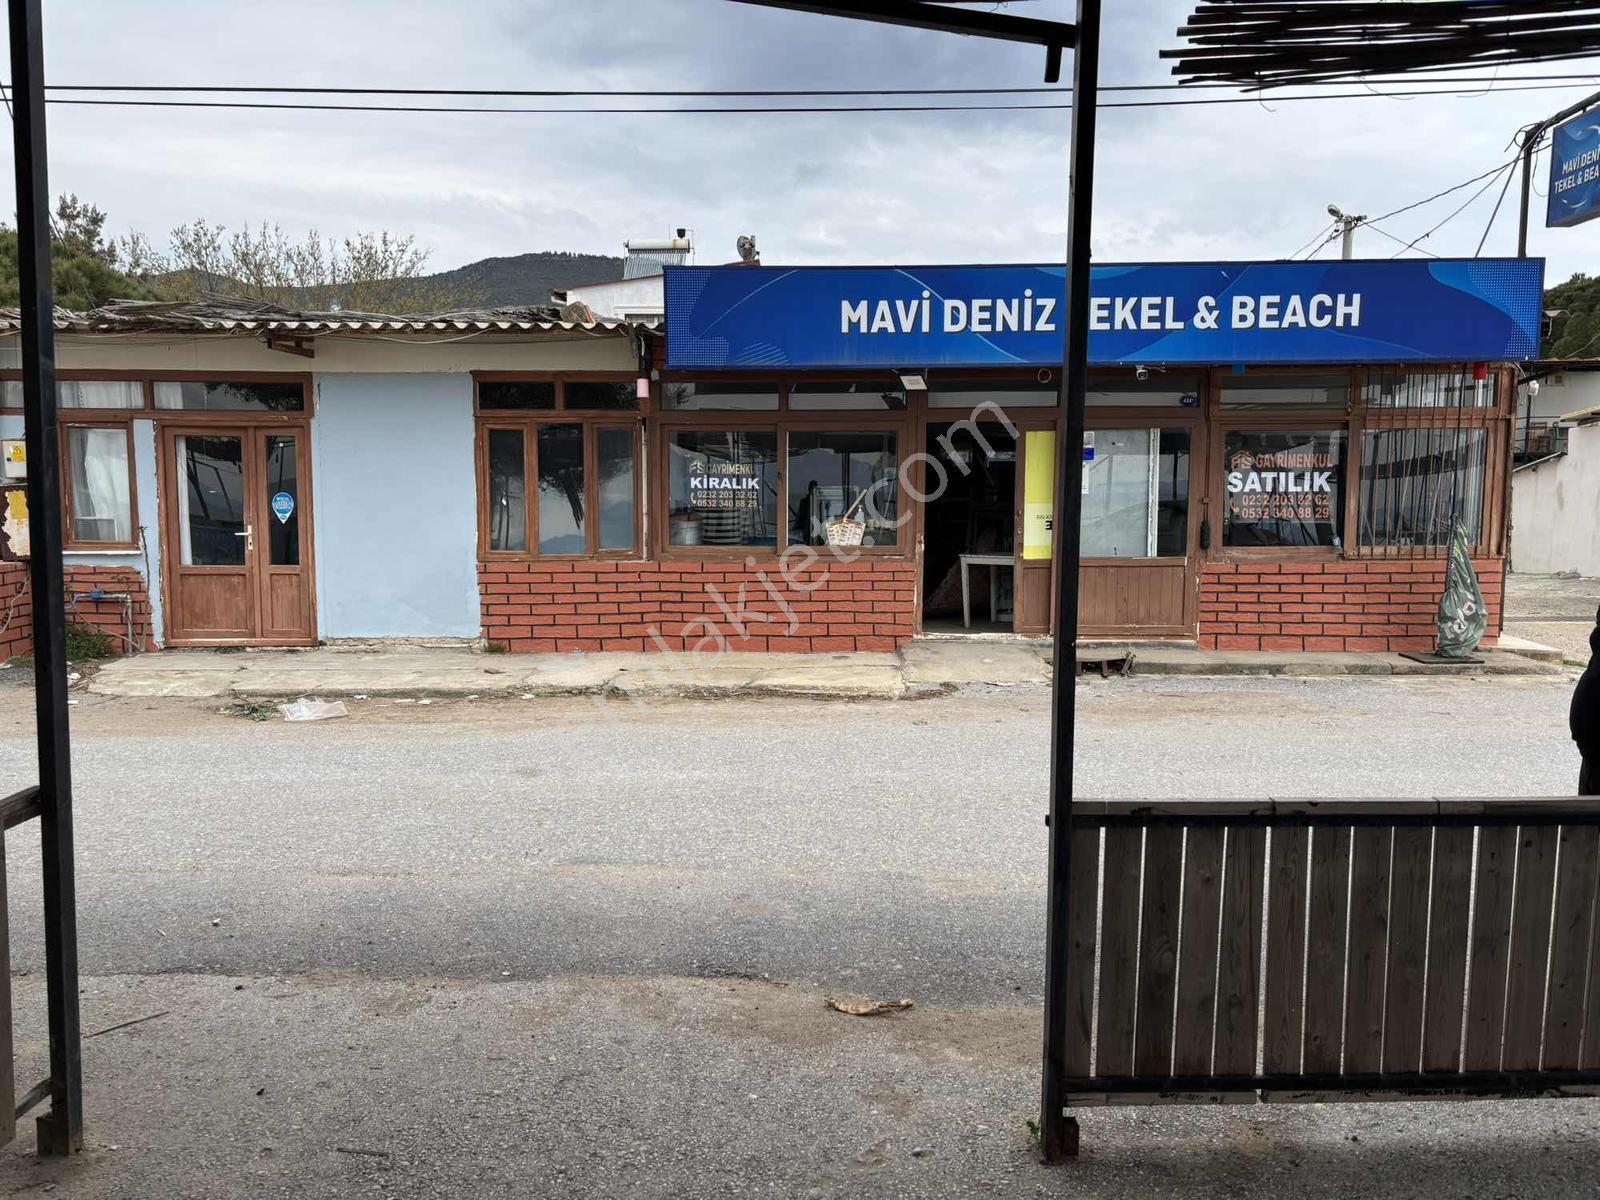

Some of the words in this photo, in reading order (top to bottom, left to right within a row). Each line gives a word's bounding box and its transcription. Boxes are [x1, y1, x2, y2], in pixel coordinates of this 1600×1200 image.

[1562, 153, 1581, 175] MAVİ
[1581, 144, 1600, 168] DENİ
[1554, 175, 1577, 194] TEKEL
[1576, 171, 1583, 184] &
[1584, 164, 1600, 182] BEA
[841, 290, 930, 333] MAVİ
[944, 288, 1056, 332] DENİZ
[1088, 296, 1185, 330] EKEL
[1193, 294, 1220, 329] &
[1231, 293, 1361, 329] BEACH
[706, 463, 757, 474] AYRİMENK
[690, 475, 760, 489] KİRALIK
[1227, 471, 1332, 493] SATILIK
[697, 490, 717, 498] 0232
[719, 490, 733, 498] 203
[1242, 494, 1270, 505] 0232
[1314, 494, 1330, 505] 62
[697, 499, 717, 507] 0532
[719, 499, 733, 507] 340
[1241, 507, 1270, 518] 0532
[1273, 507, 1294, 518] 340
[1315, 507, 1329, 518] 29
